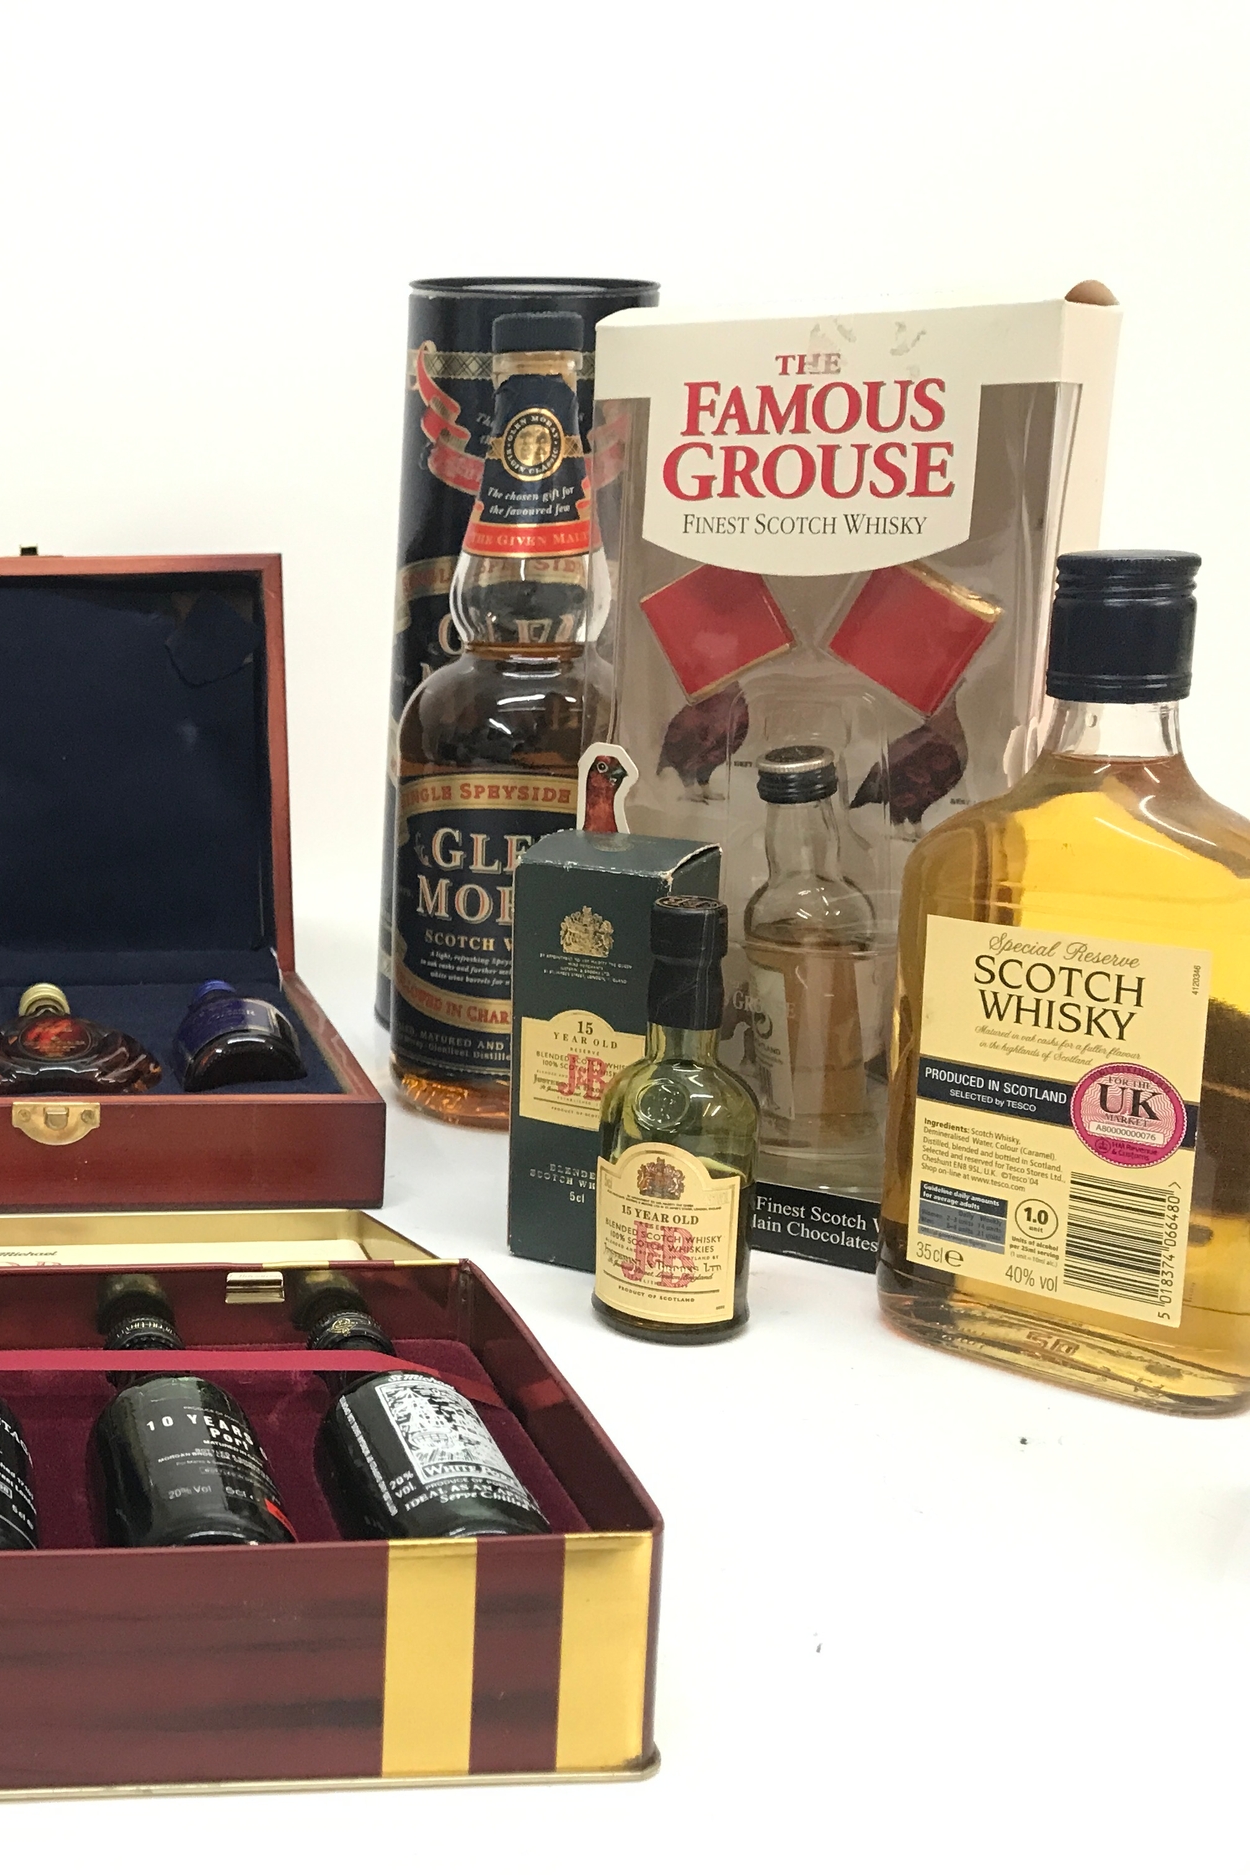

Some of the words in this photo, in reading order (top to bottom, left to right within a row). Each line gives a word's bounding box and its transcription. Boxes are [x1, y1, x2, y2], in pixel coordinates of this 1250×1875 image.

[775, 352, 841, 376] THE
[680, 378, 946, 437] FAMOUS
[662, 442, 955, 502] GROUSE
[488, 486, 502, 500] The
[505, 490, 539, 501] chosen
[542, 488, 559, 503] gift
[561, 486, 574, 500] for
[489, 505, 504, 515] the
[505, 505, 553, 518] favoured
[555, 504, 571, 515] few
[682, 513, 749, 535] FINEST
[754, 513, 837, 535] SCOTCH
[843, 513, 928, 536] WHISKY
[497, 529, 547, 546] GIVEN
[459, 783, 572, 804] SPEYSIDE
[432, 827, 534, 875] GLE
[425, 929, 495, 951] SCOTCH
[989, 932, 1061, 958] Special
[1063, 941, 1140, 969] Reserve
[974, 955, 1146, 1008] SCOTCH
[1192, 965, 1201, 995] 4120346
[977, 989, 1137, 1042] WHISKY
[577, 1021, 593, 1035] 15
[420, 1030, 472, 1047] MATURED
[477, 1041, 504, 1050] AND
[554, 1032, 587, 1045] YEAR
[593, 1039, 618, 1049] OLD
[925, 1067, 985, 1089] PRODUCED
[988, 1079, 1000, 1092] IN
[1003, 1082, 1067, 1105] SCOTLAND
[949, 1088, 994, 1105] SELECTED
[995, 1097, 1005, 1108] by
[1007, 1099, 1037, 1112] TESCO
[1097, 1083, 1162, 1121] UK
[924, 1118, 969, 1134] Ingredients:
[971, 1128, 993, 1138] Scotch
[1105, 1114, 1148, 1127] MARKET
[924, 1127, 969, 1143] Demineralised
[995, 1142, 1018, 1153] Colour
[923, 1136, 950, 1149] Distilled,
[952, 1142, 979, 1155] blended
[980, 1150, 993, 1158] and
[995, 1152, 1020, 1163] bottled
[1030, 1160, 1062, 1172] Scotland.
[923, 1145, 949, 1156] Selected
[951, 1152, 963, 1161] and
[965, 1155, 993, 1167] reserved
[995, 1161, 1004, 1169] for
[1006, 1164, 1024, 1173] Tesco
[1026, 1168, 1048, 1179] Stores
[550, 1163, 596, 1179] BLENDE
[921, 1163, 937, 1173] Shop
[938, 1167, 961, 1179] on-line
[971, 1176, 1026, 1192] www.tesco.com
[924, 1184, 953, 1195] Guideline
[954, 1190, 970, 1201] daily
[971, 1196, 999, 1207] amounts
[933, 1194, 959, 1205] average
[959, 1199, 980, 1210] adults
[622, 1204, 632, 1215] 15
[634, 1208, 669, 1223] YEAR
[673, 1214, 699, 1225] OLD
[756, 1196, 805, 1219] Finest
[811, 1206, 867, 1232] Scotch
[1024, 1207, 1049, 1225] 1.0
[605, 1218, 638, 1235] BLENDED
[641, 1231, 681, 1243] SCOTCH
[686, 1235, 722, 1244] WHISKY
[610, 1230, 625, 1242] 100%
[668, 1245, 714, 1253] WHISKIES
[752, 1214, 782, 1233] lain
[787, 1221, 878, 1253] Chocolates
[1009, 1243, 1019, 1251] per
[1037, 1249, 1060, 1260] serving
[1005, 1265, 1035, 1287] 40%
[1040, 1276, 1058, 1292] vol
[147, 1416, 174, 1431] 10
[187, 1414, 254, 1445] YEARS
[210, 1428, 248, 1450] Port
[389, 1471, 414, 1490] 20%
[424, 1464, 476, 1476] WHITE
[405, 1488, 448, 1511] IDEAL
[451, 1484, 469, 1492] AS
[473, 1484, 492, 1492] AN
[440, 1492, 477, 1503] Serve
[480, 1491, 530, 1512] Chilled
